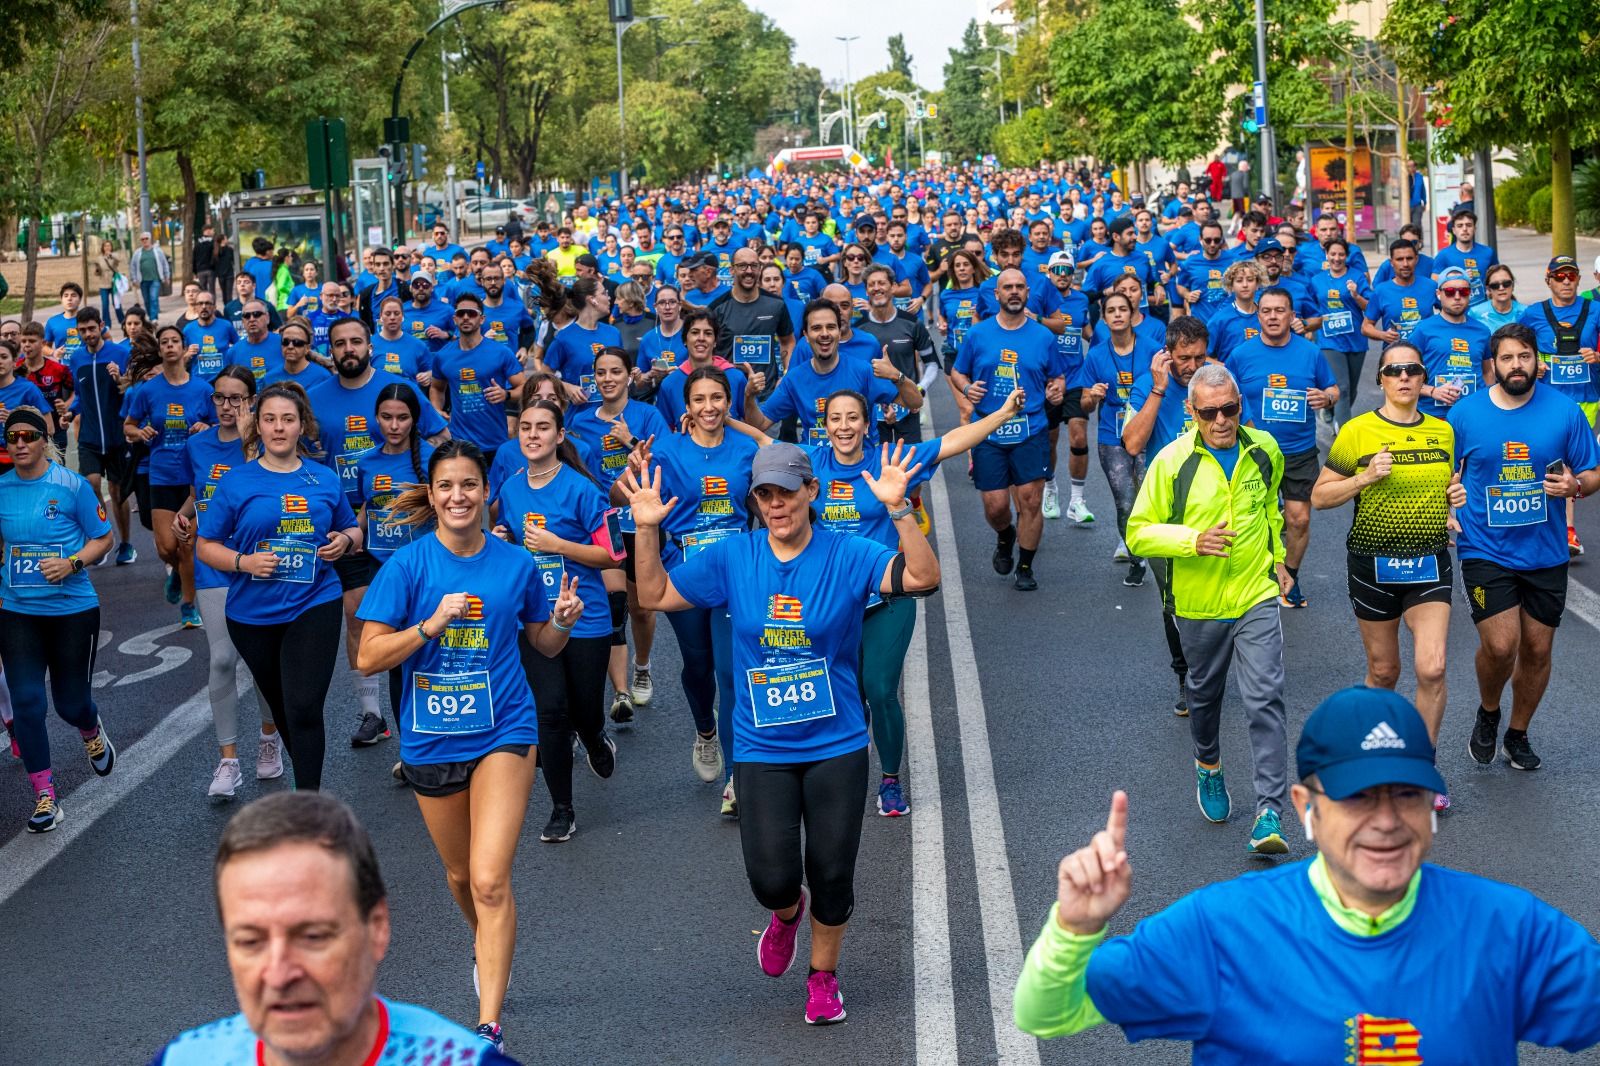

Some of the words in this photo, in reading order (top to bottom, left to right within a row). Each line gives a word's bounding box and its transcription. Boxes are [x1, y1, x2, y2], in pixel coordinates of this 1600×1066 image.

[1328, 318, 1347, 329] 668
[1058, 336, 1077, 345] 569
[740, 345, 763, 354] 991
[200, 360, 220, 368] 1008
[1559, 365, 1583, 375] 766
[1272, 399, 1298, 411] 602
[996, 424, 1021, 435] 820
[1391, 453, 1414, 462] ATAS
[1417, 451, 1444, 461] TRAIL
[1493, 496, 1542, 513] 4005
[376, 523, 403, 538] 504
[14, 559, 44, 574] 124
[279, 554, 304, 568] 48
[440, 637, 446, 646] X
[448, 637, 489, 648] VALENCIA
[760, 637, 765, 646] X
[768, 637, 812, 647] VALENCIA
[767, 681, 817, 706] 848
[428, 695, 477, 715] 692
[1361, 736, 1405, 749] adidas
